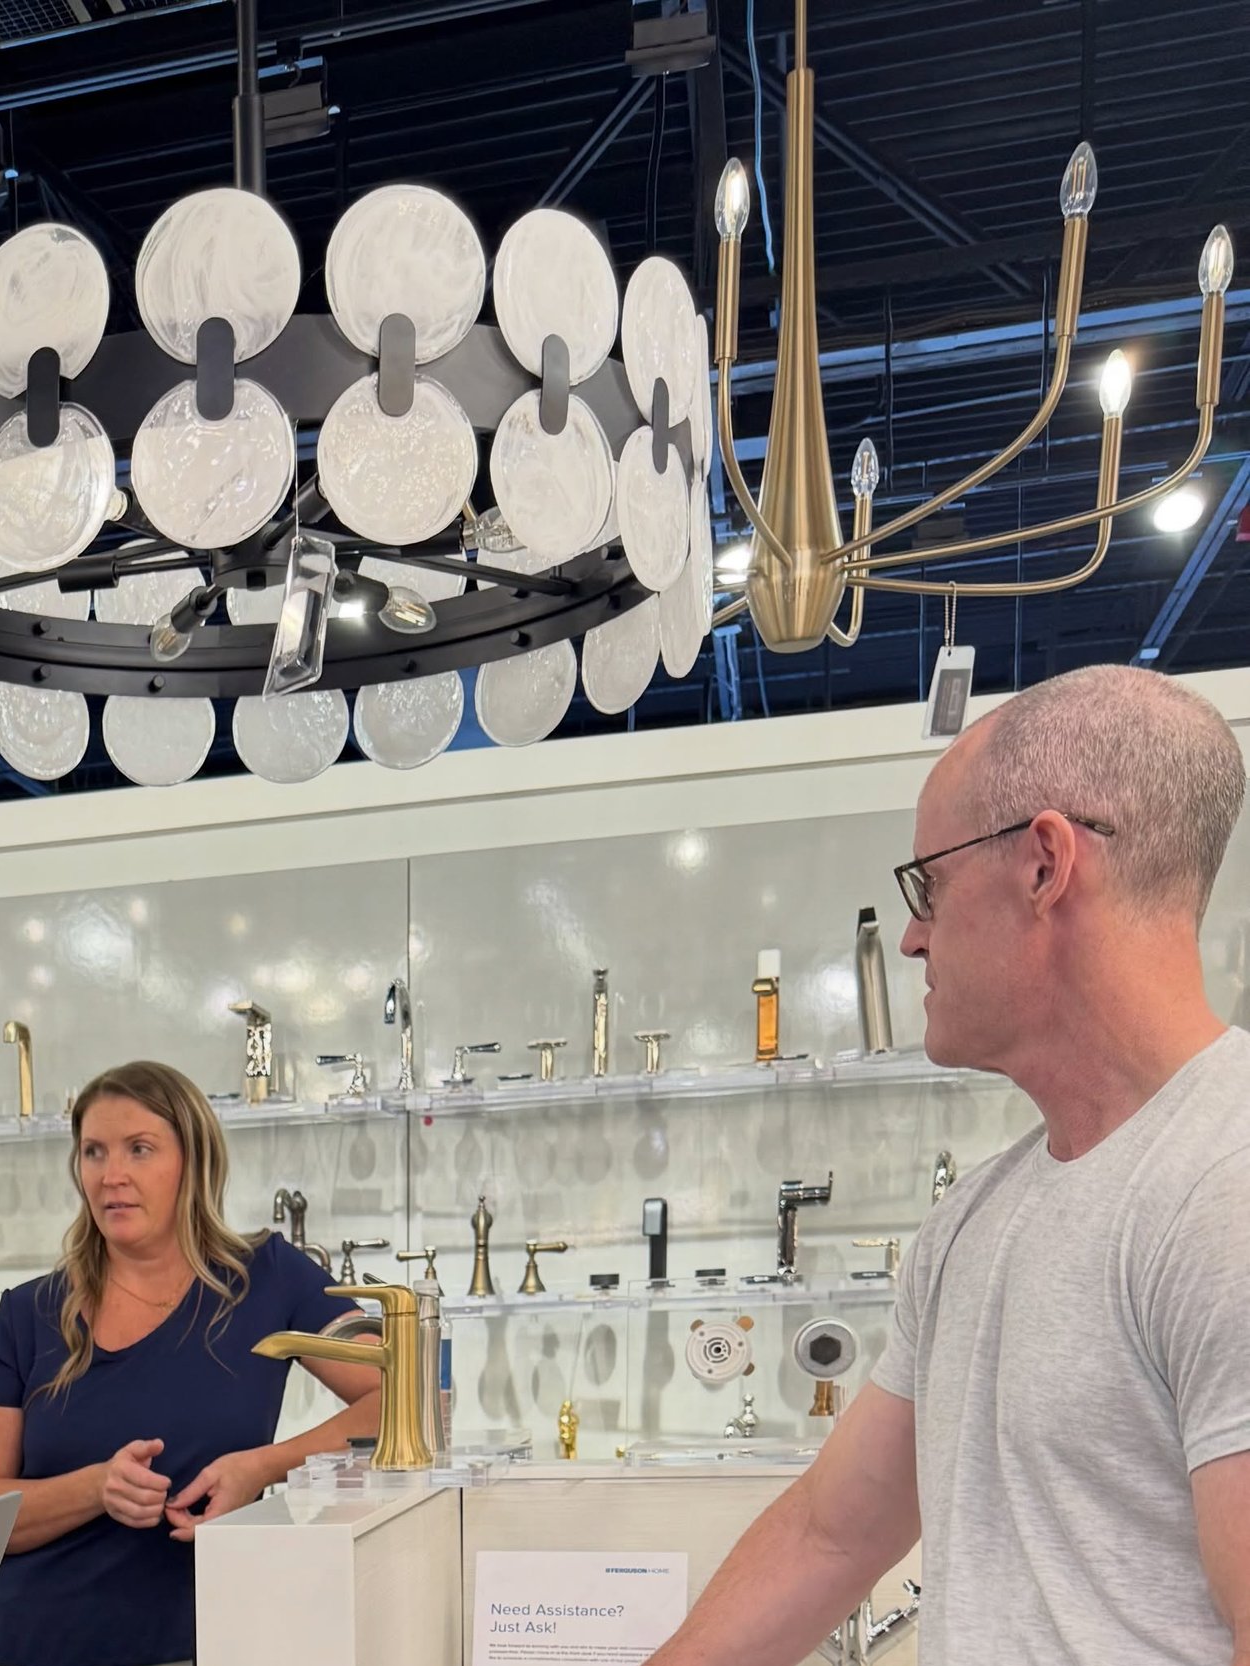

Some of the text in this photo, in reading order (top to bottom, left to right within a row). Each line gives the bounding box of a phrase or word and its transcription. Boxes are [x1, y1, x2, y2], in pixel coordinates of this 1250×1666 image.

[490, 1603, 625, 1617] Need Assistance?
[489, 1620, 557, 1634] Just Ask!
